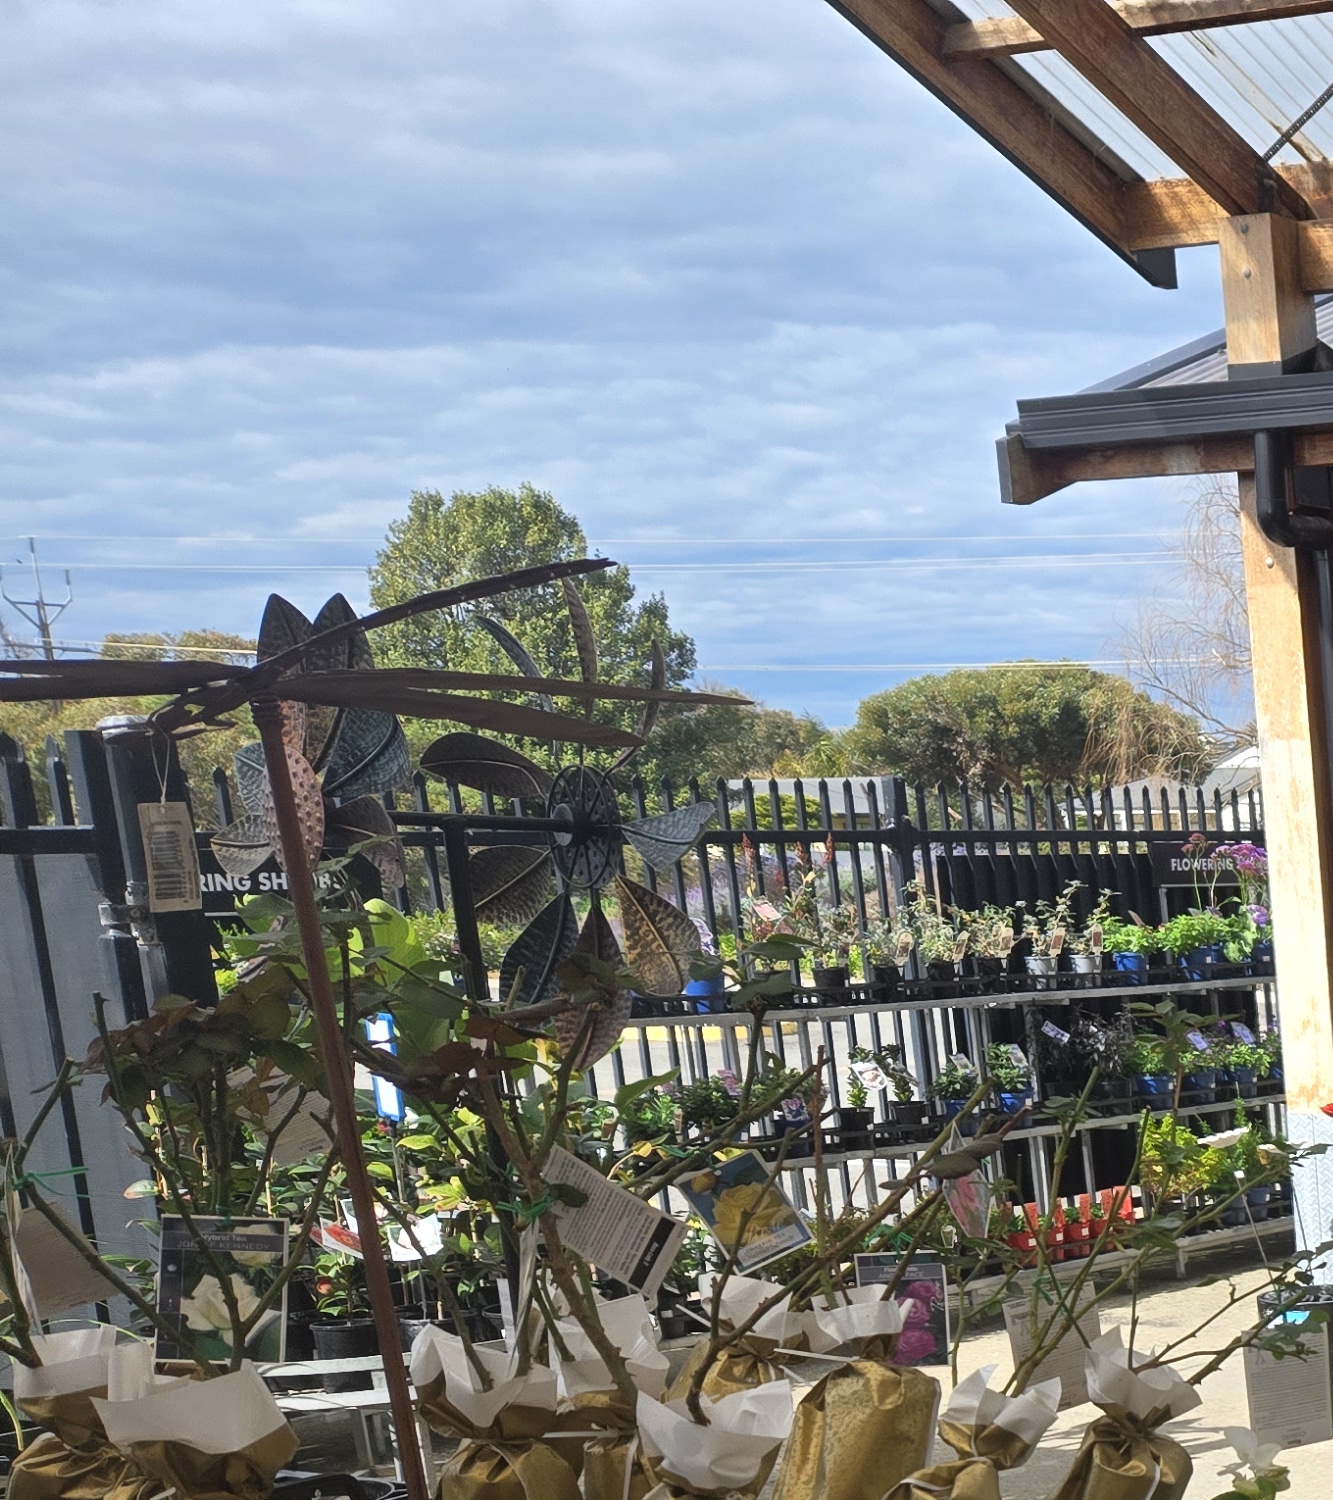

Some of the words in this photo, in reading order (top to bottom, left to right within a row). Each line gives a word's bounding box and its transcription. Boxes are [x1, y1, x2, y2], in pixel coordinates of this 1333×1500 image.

[1171, 858, 1234, 871] FLOWERNG
[258, 872, 342, 891] SHBS
[177, 1240, 198, 1248] JOH
[219, 1242, 270, 1250] KENNEDY
